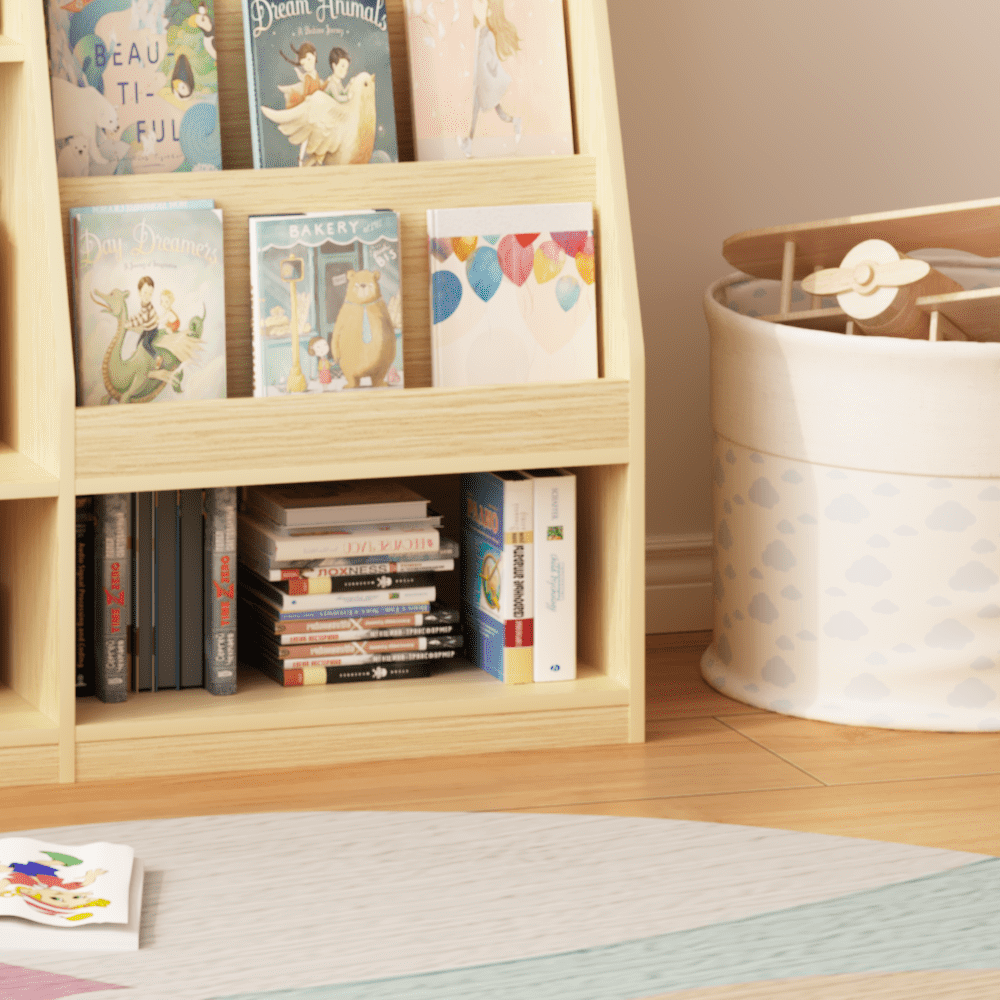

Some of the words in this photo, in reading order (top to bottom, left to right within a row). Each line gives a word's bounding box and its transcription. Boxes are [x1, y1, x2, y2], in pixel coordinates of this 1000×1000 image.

[136, 118, 180, 143] FUL
[289, 220, 360, 239] BAKERY
[79, 229, 123, 268] Day
[131, 218, 218, 265] Dreamers
